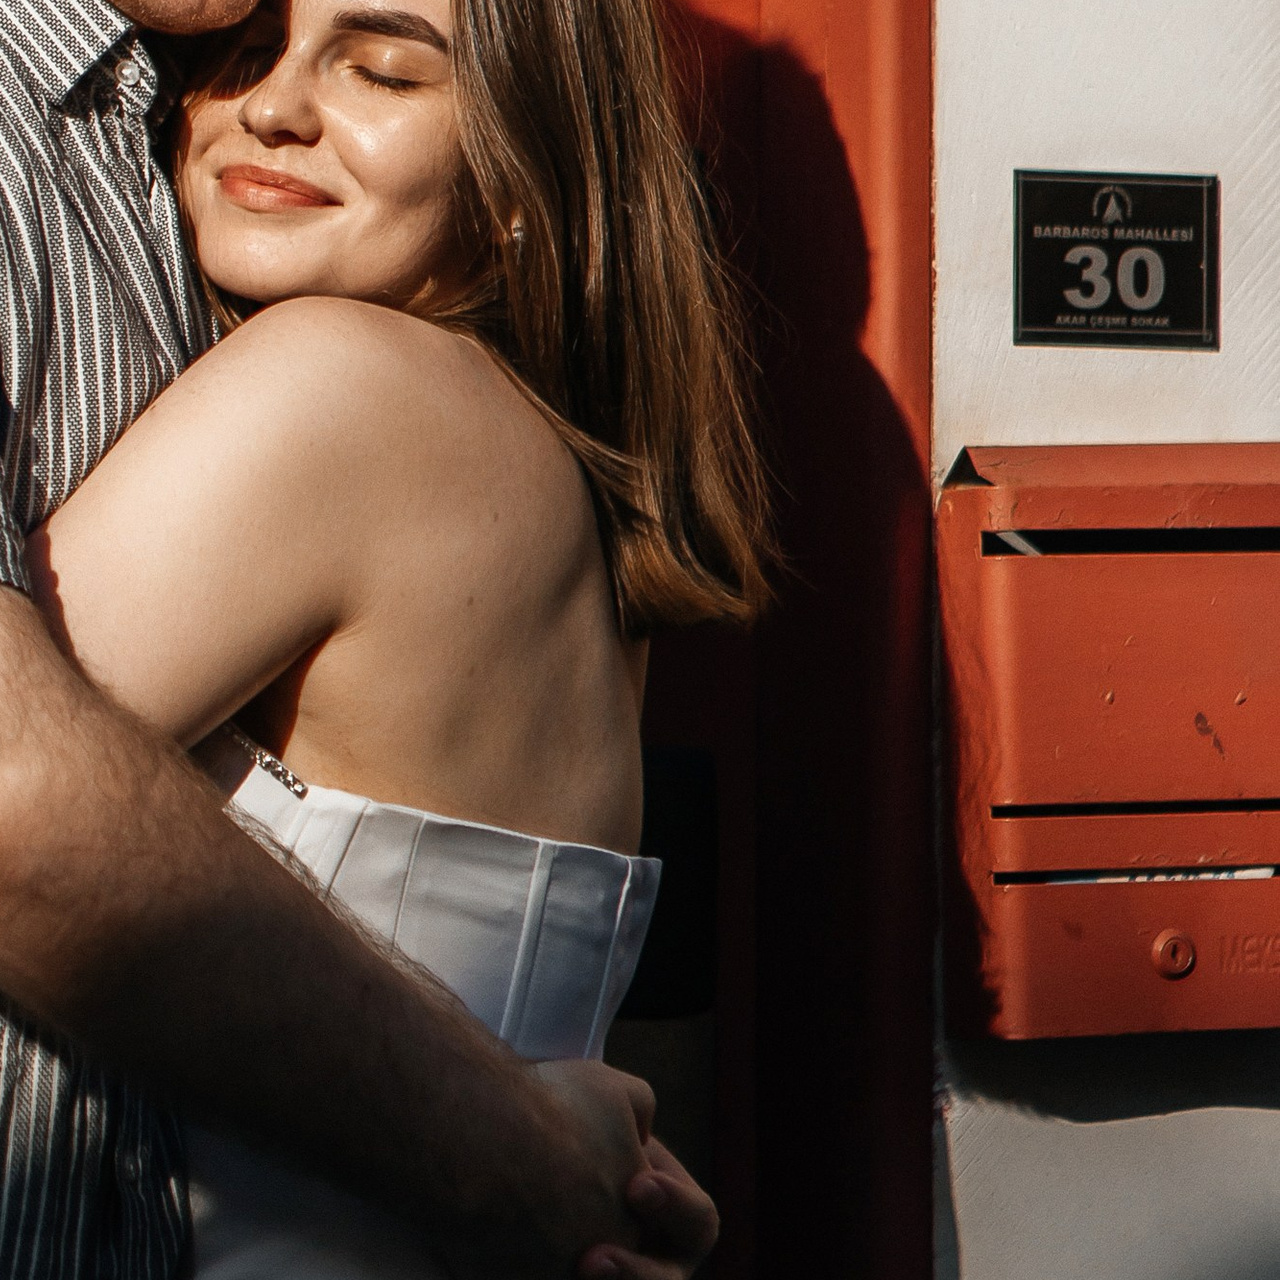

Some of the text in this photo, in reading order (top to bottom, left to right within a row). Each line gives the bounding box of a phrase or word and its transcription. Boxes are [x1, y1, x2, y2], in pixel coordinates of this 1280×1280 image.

[1032, 224, 1194, 242] BARBAROS MAHALLESİ
[1062, 244, 1166, 311] 30
